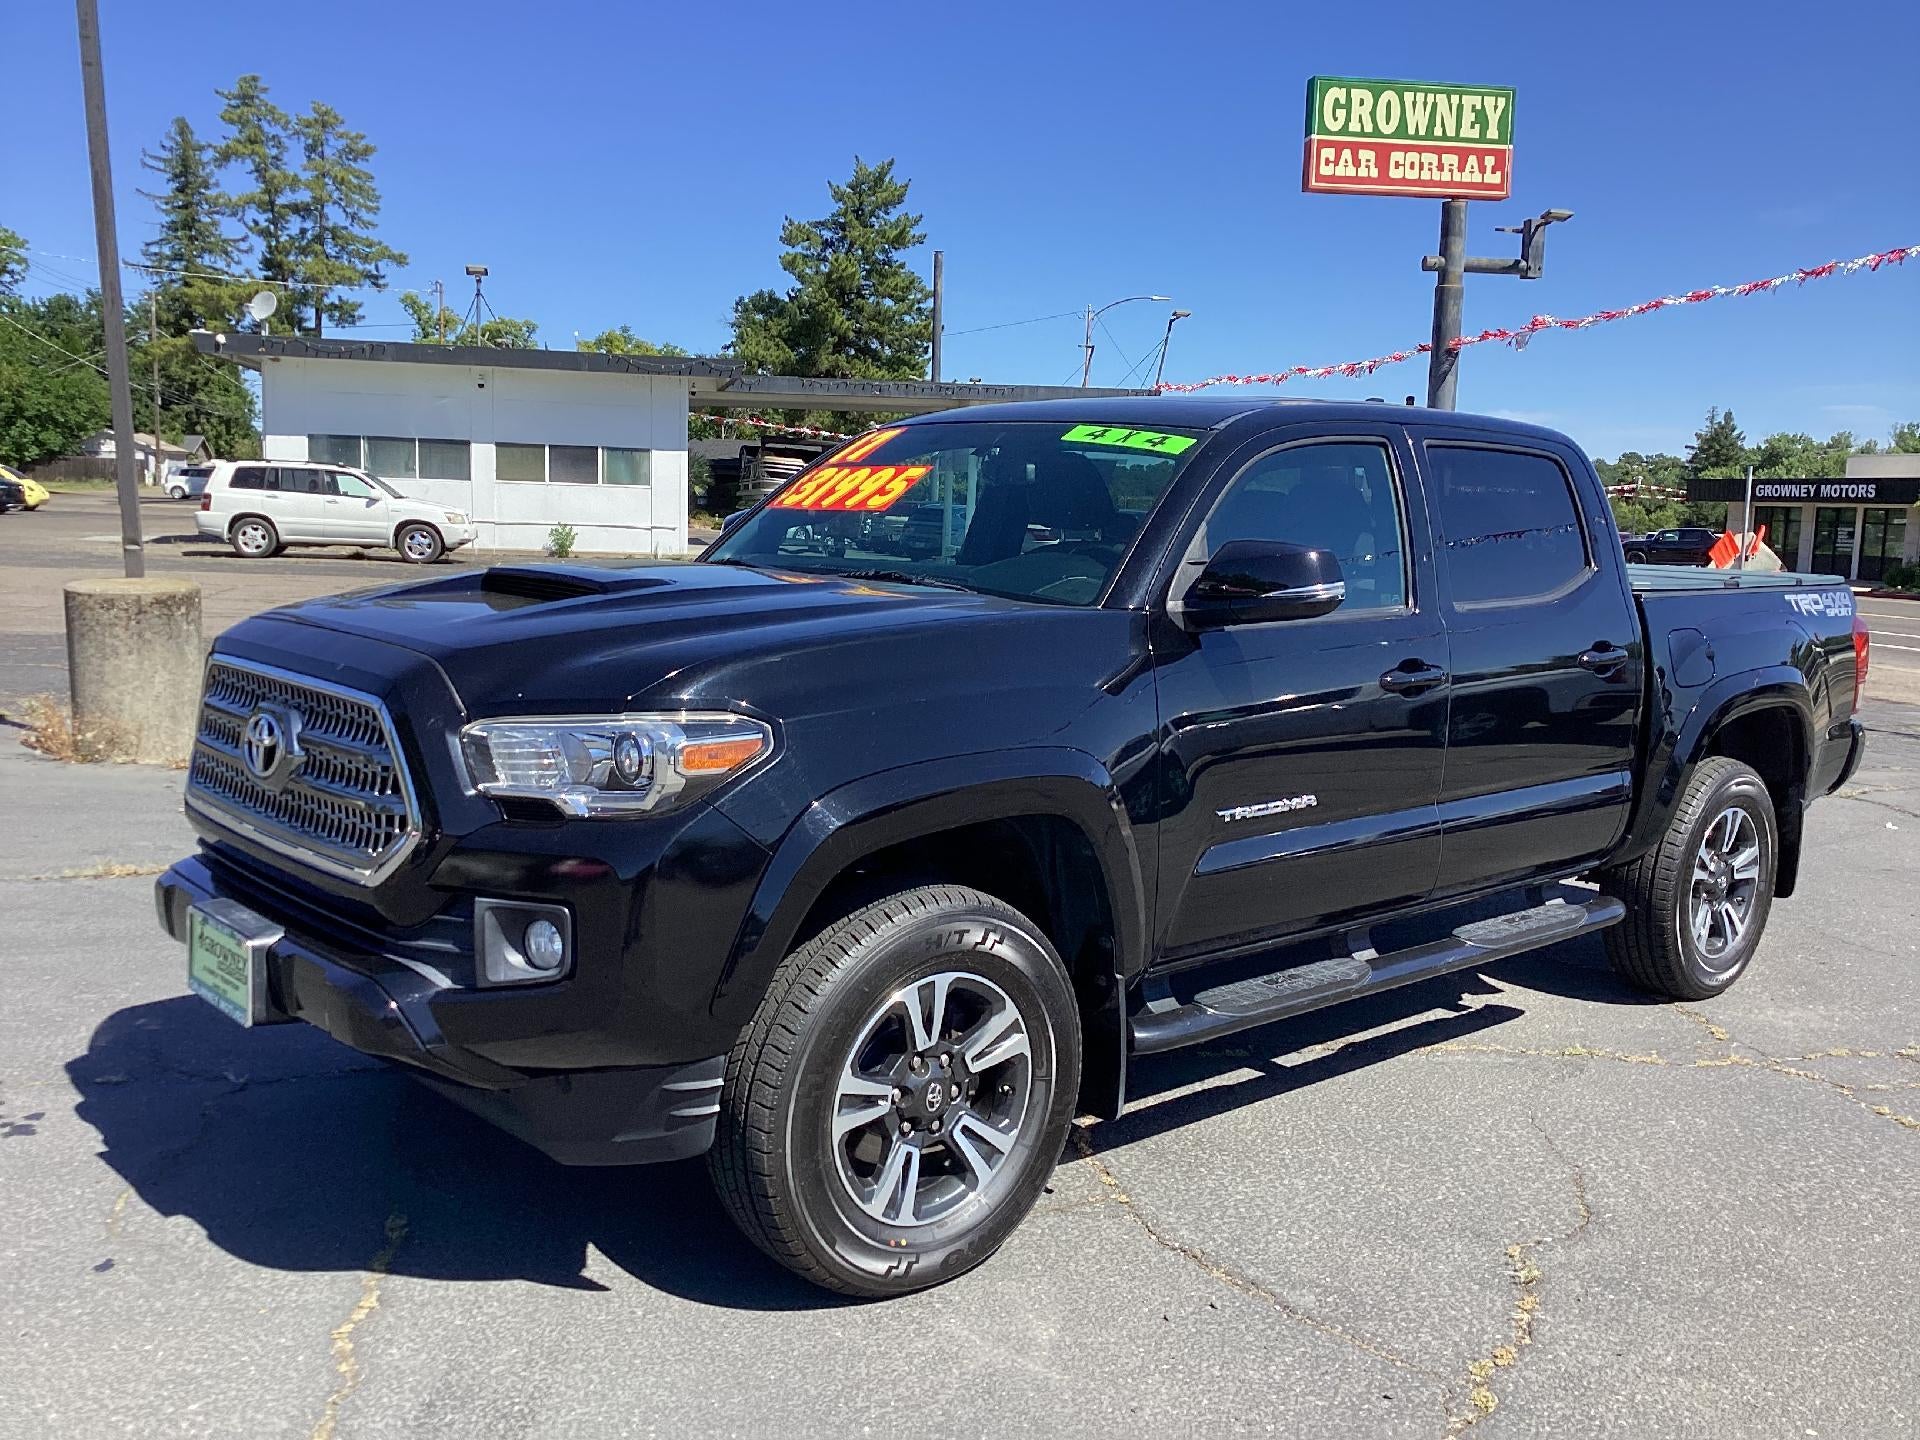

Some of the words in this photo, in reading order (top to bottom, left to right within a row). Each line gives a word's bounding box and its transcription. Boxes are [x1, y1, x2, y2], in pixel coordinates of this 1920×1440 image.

[1323, 87, 1506, 139] GROWNEY
[1319, 147, 1379, 178] CAR
[1388, 151, 1502, 184] CORRAL
[1755, 483, 1817, 498] GROWNEY
[1820, 484, 1877, 498] MOTORS
[1784, 593, 1825, 616] TRD
[1825, 607, 1852, 617] SPORT
[1216, 795, 1318, 823] TACOMA
